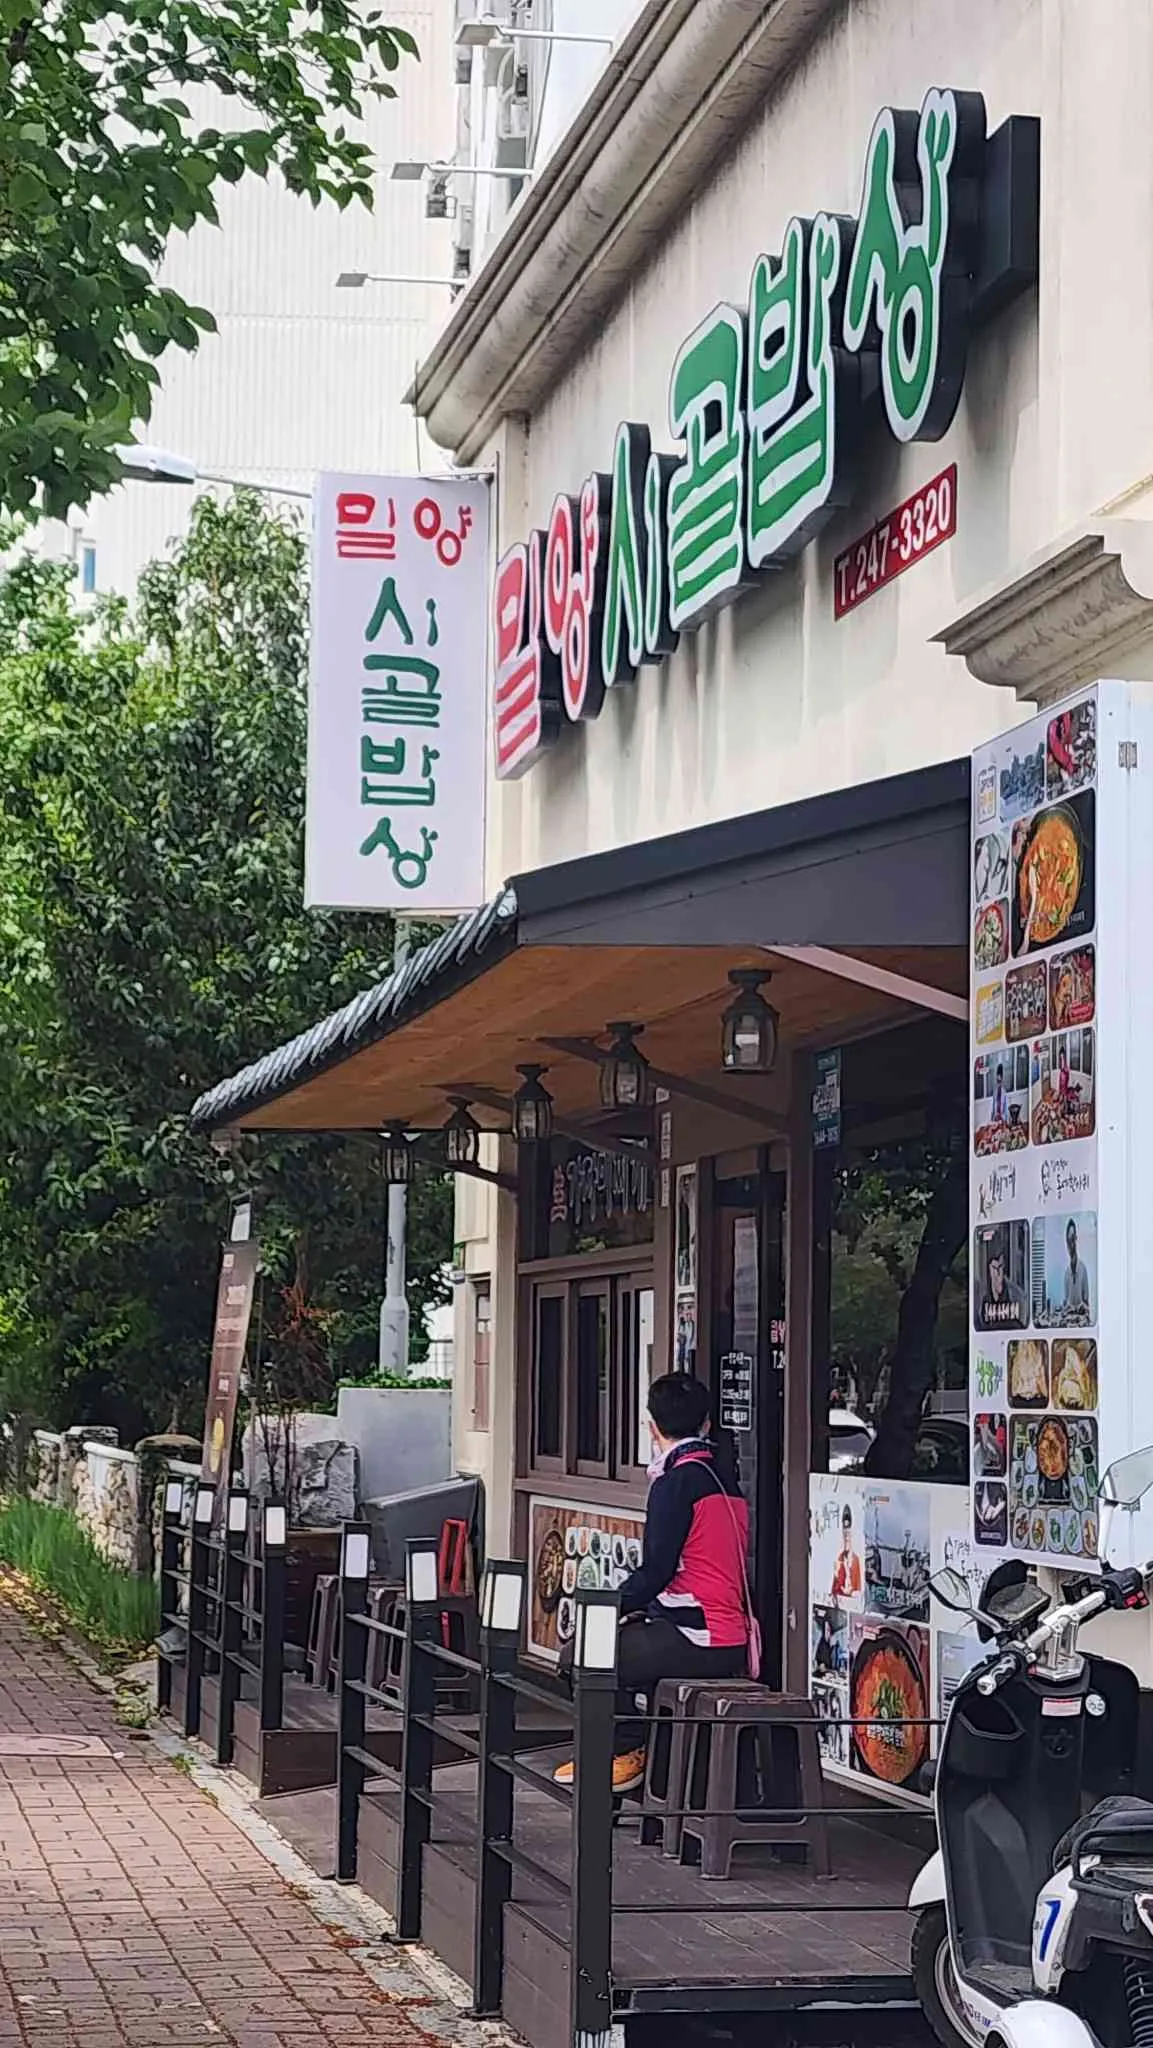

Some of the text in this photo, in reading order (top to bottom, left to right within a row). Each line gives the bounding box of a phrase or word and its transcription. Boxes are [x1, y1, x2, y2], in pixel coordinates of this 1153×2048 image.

[335, 492, 472, 567] 밀양
[838, 478, 951, 607] T.247-3320
[360, 577, 442, 889] 시골밥상
